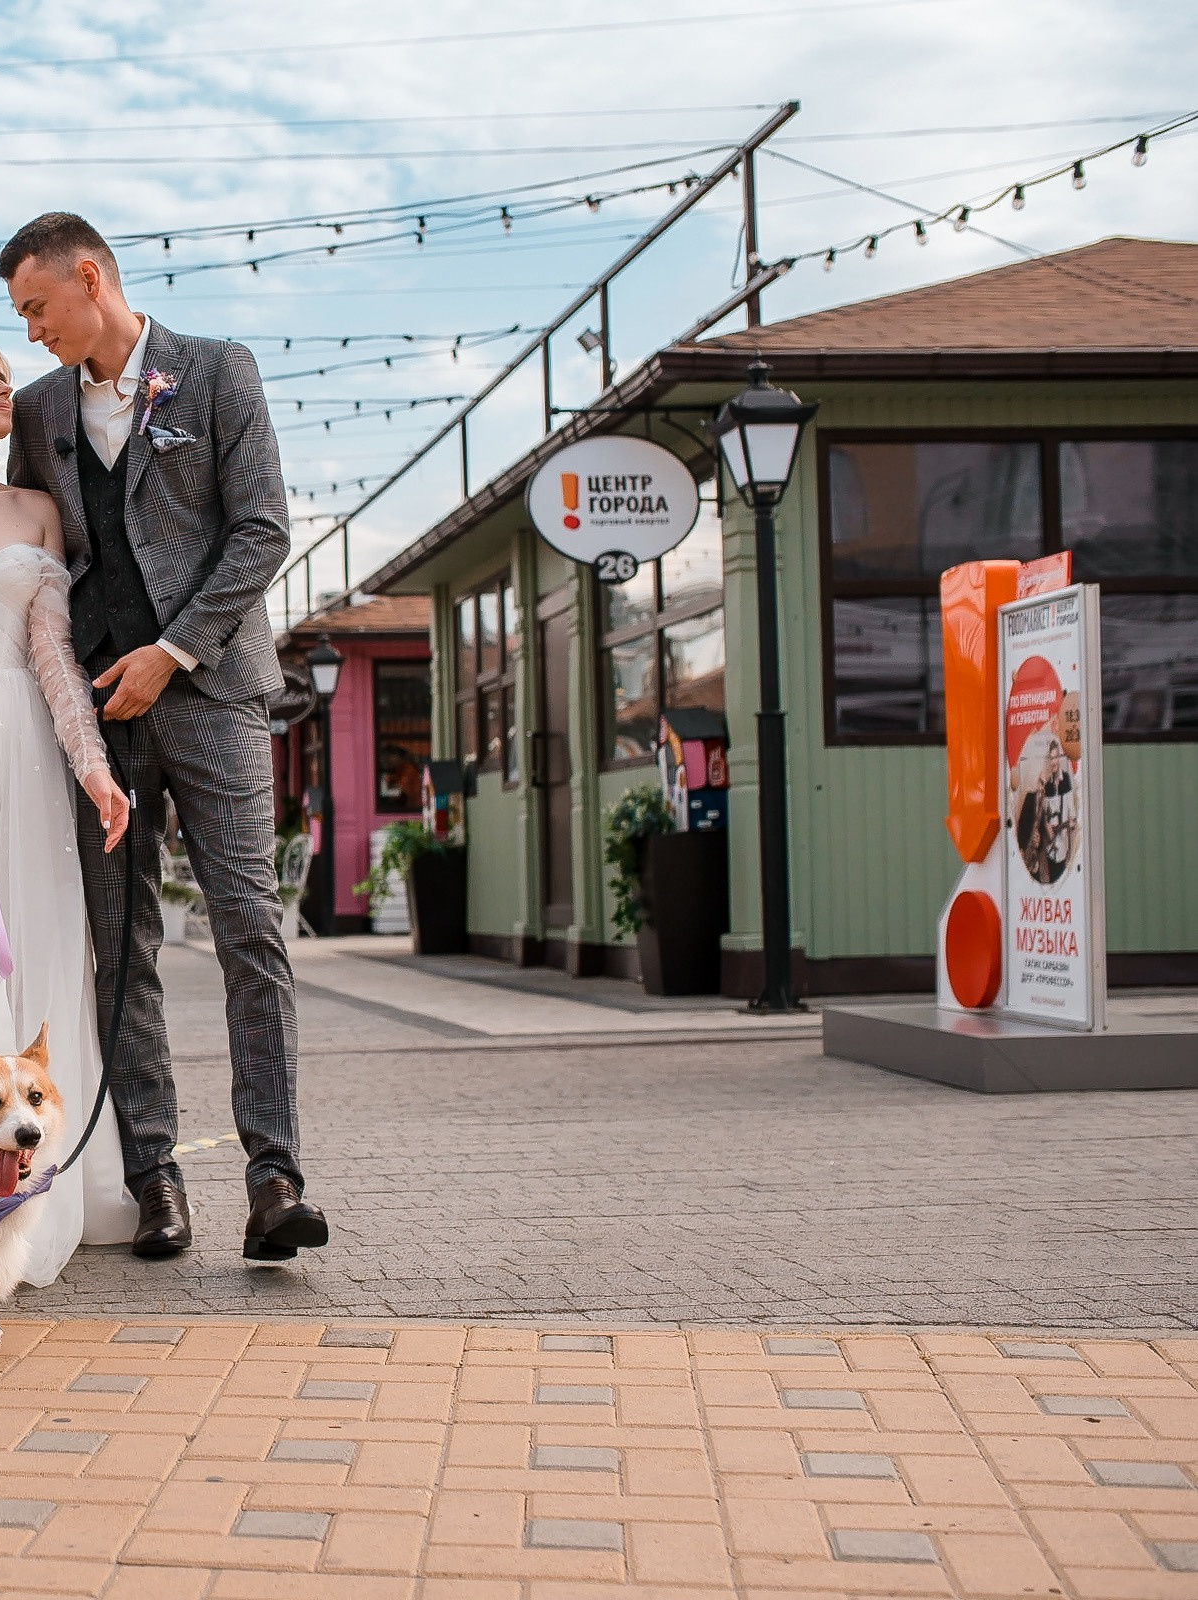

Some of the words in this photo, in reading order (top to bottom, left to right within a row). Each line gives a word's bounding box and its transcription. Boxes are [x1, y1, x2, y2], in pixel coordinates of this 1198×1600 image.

[588, 475, 652, 493] ЦЕНТР
[589, 496, 670, 514] ГОРОДА
[598, 553, 634, 580] 26
[1020, 897, 1072, 924] ЖИВАЯ
[1016, 927, 1079, 957] МУЗЫКА
